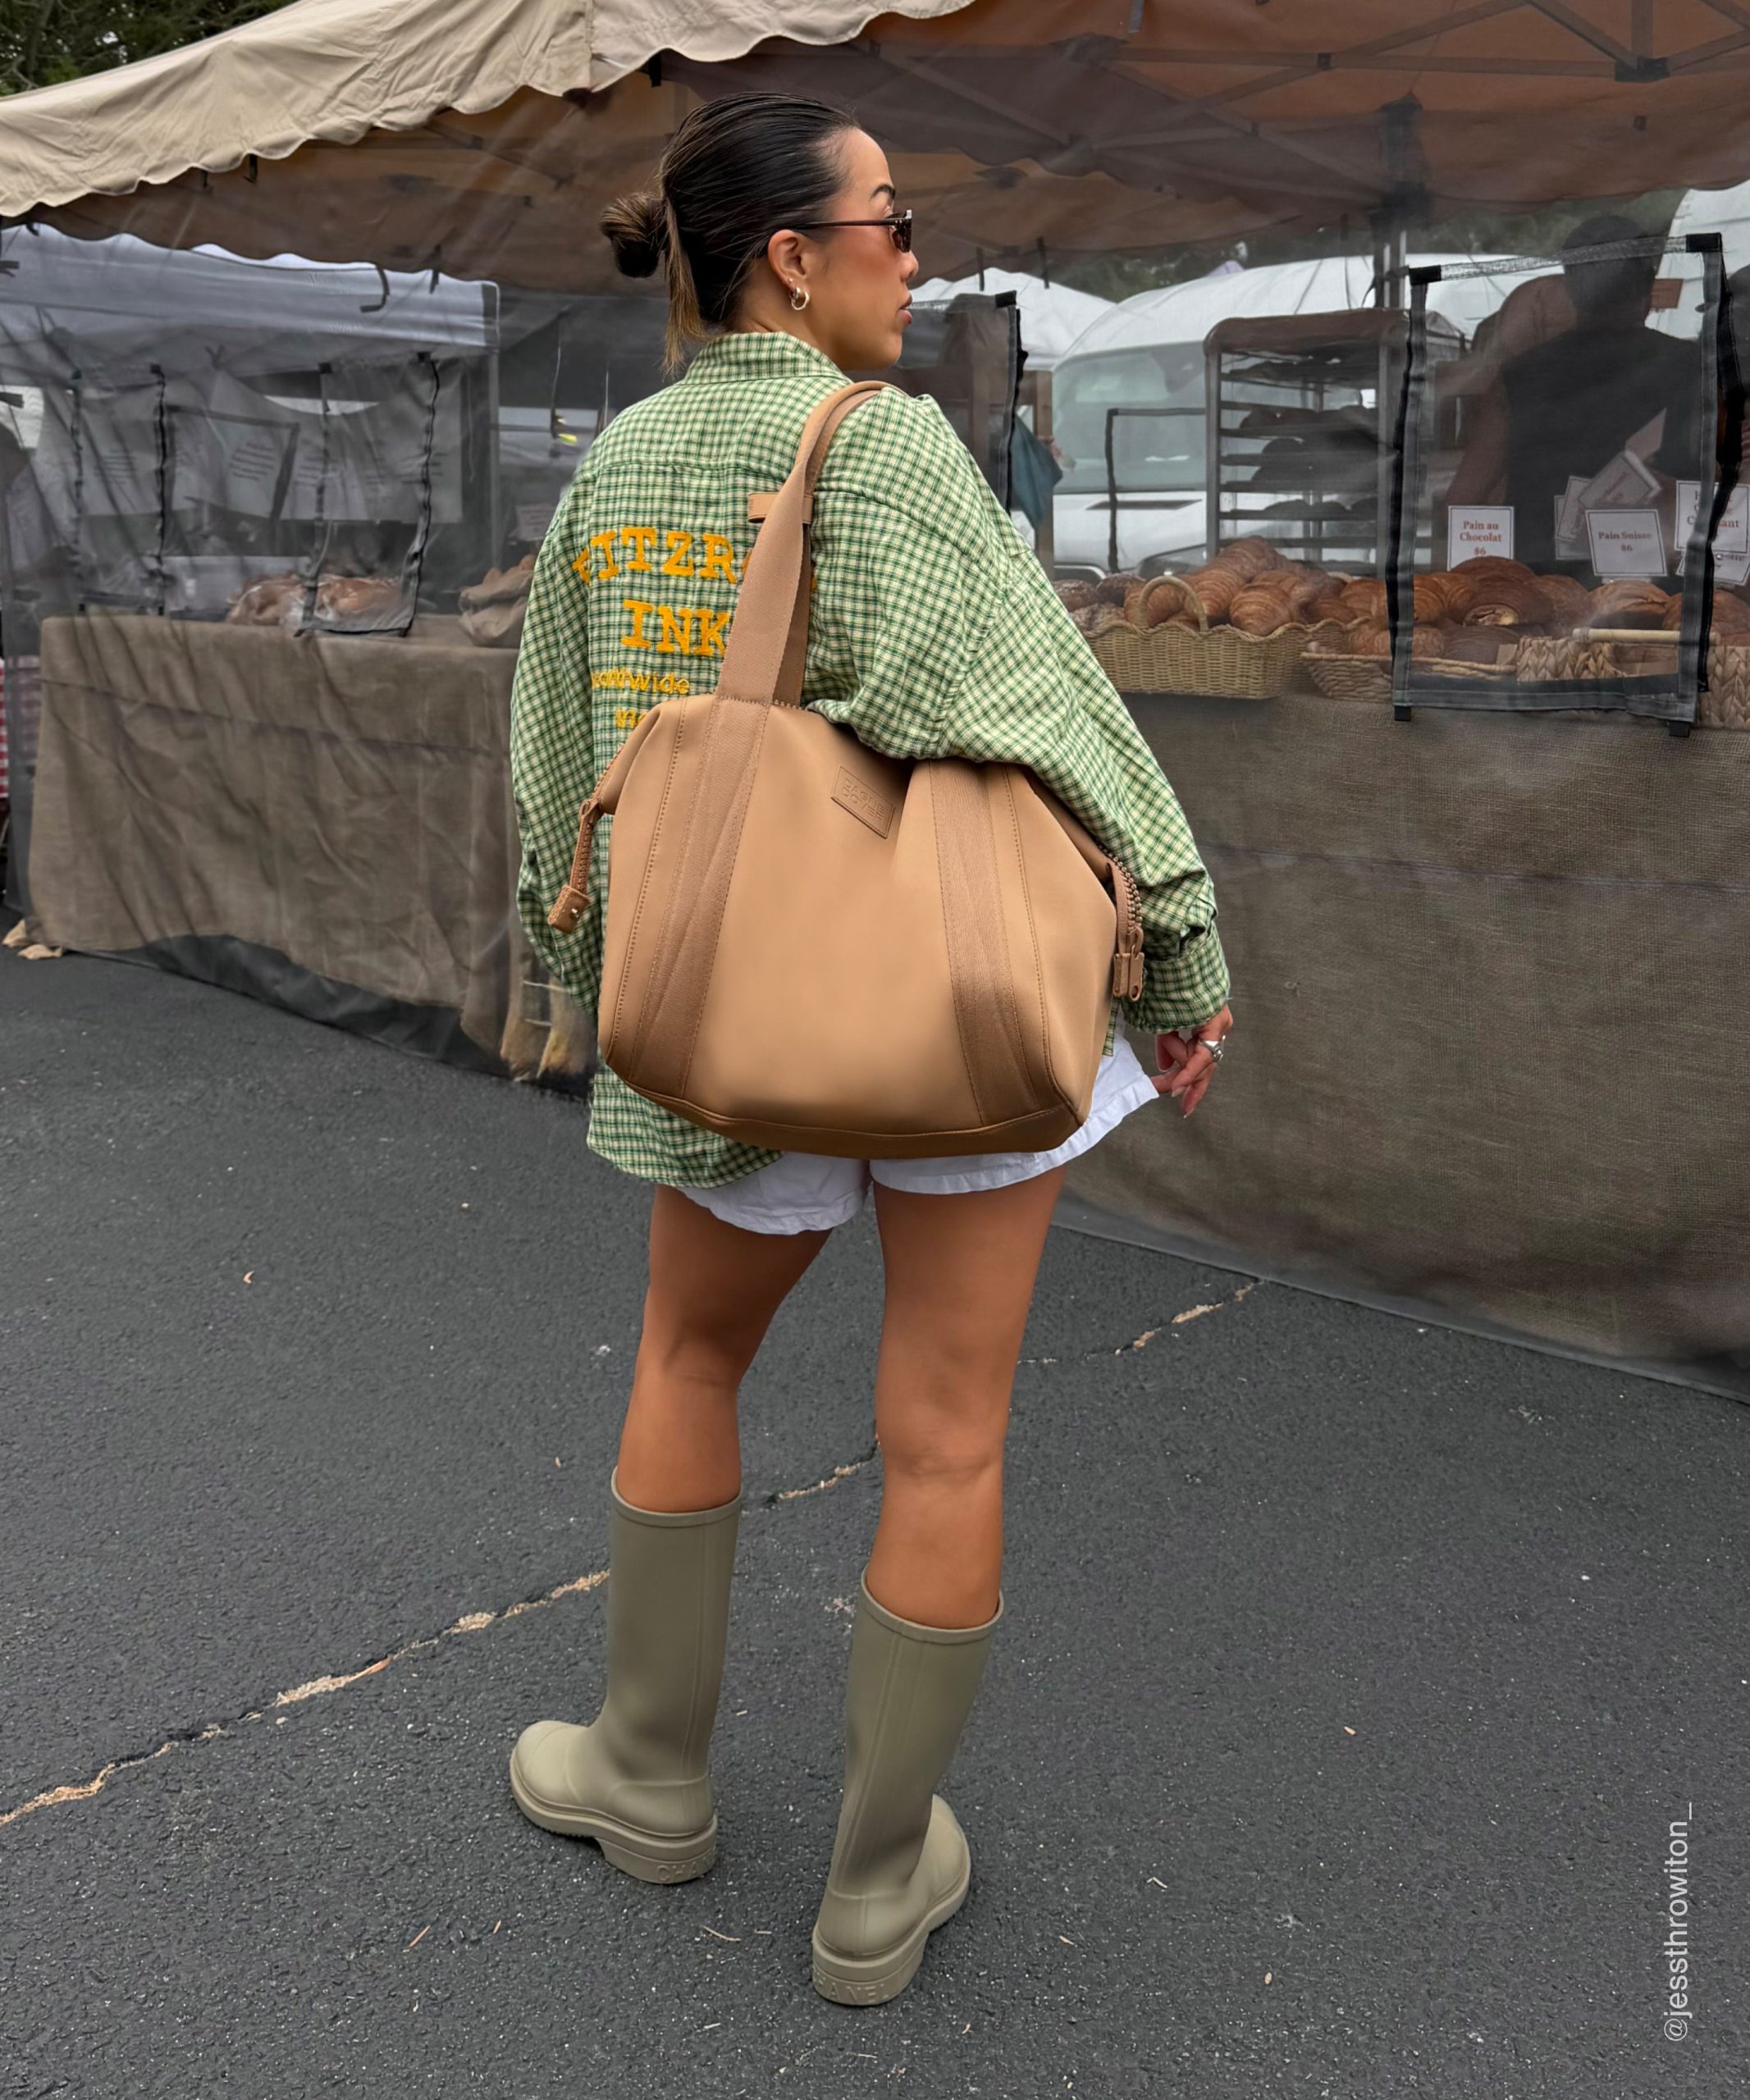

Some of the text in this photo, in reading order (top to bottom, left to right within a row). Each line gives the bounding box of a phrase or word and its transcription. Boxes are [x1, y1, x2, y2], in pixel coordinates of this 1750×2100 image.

[1463, 519, 1484, 530] Pain
[1460, 532, 1502, 542] Chocolat
[1598, 531, 1620, 540] Pain
[572, 526, 750, 586] ITZR
